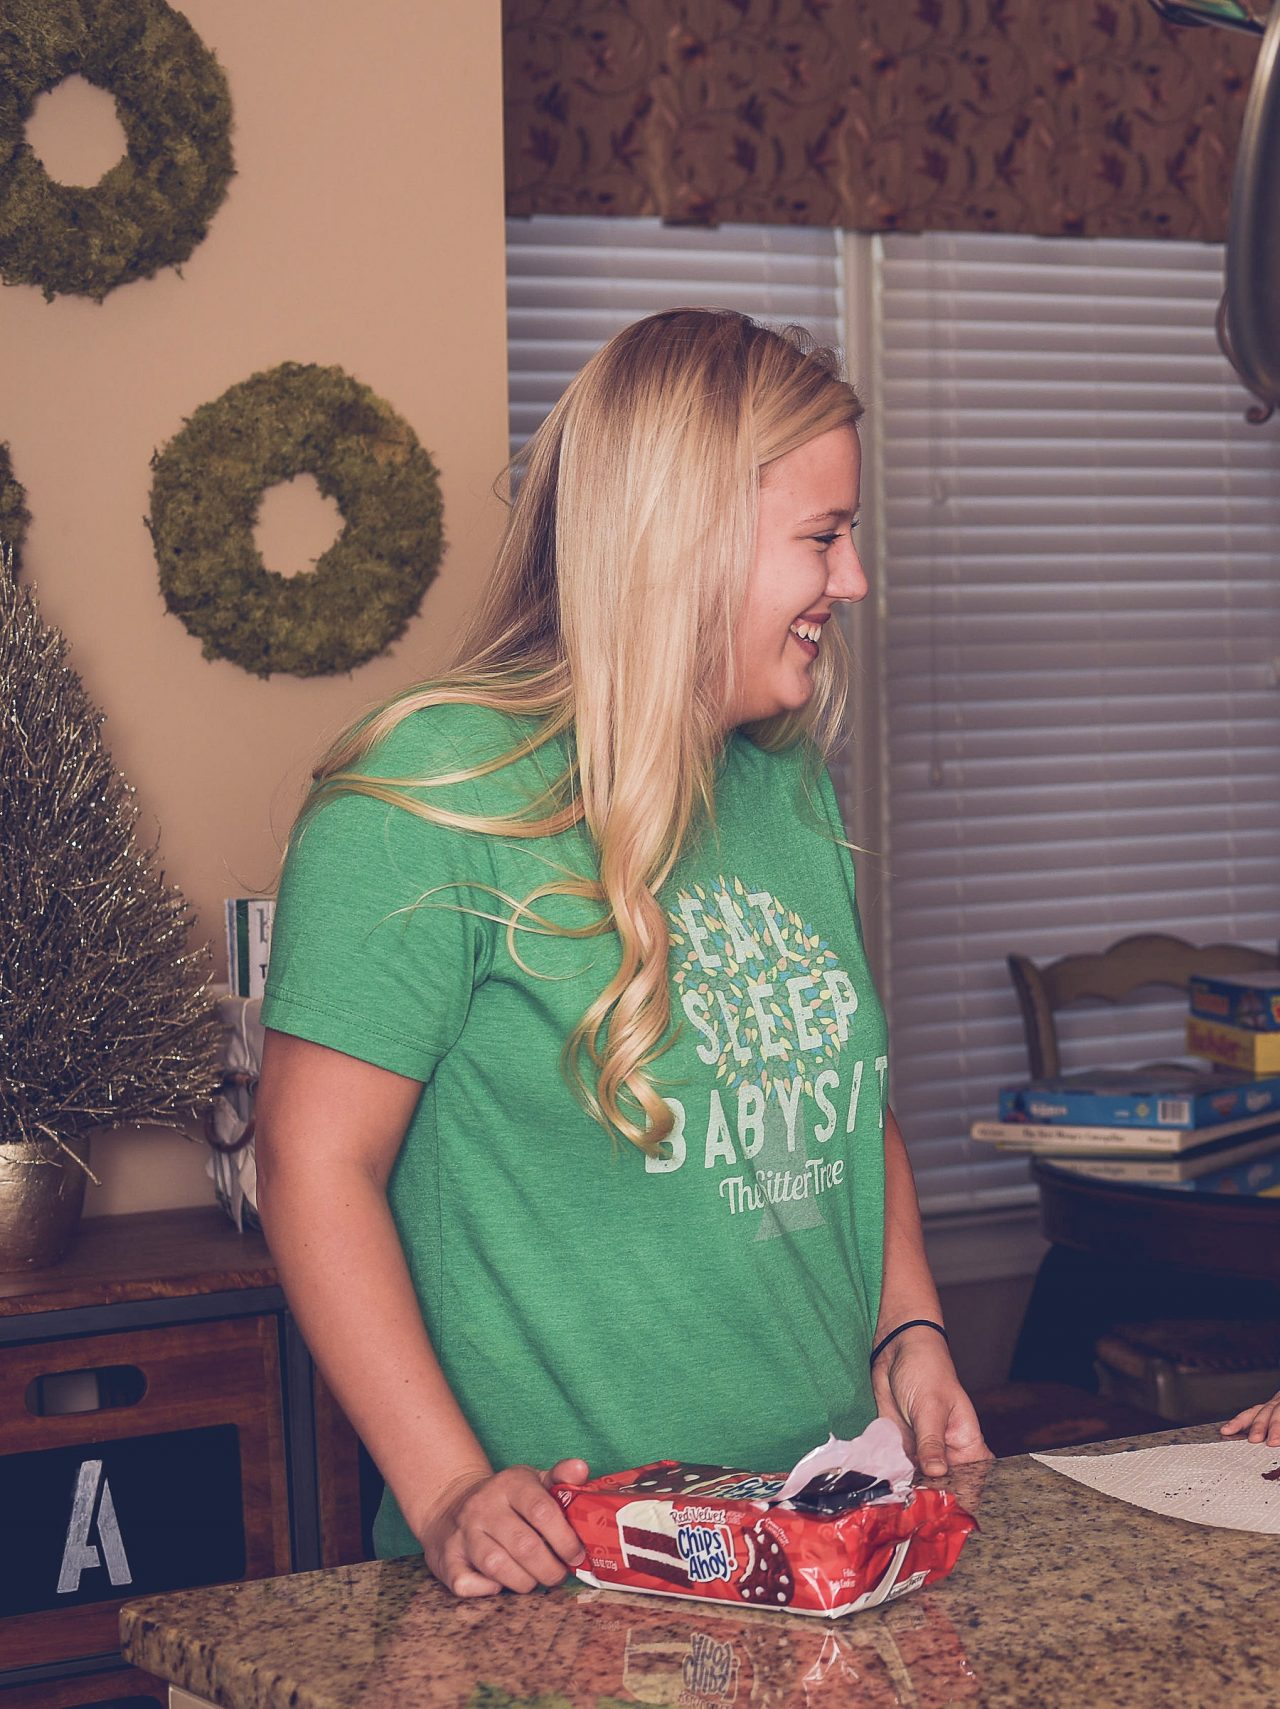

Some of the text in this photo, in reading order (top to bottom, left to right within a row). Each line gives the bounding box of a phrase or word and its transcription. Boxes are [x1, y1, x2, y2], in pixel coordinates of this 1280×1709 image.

[679, 891, 790, 969] EAT
[681, 970, 859, 1065] SLEEP
[57, 1459, 132, 1593] A
[669, 1506, 690, 1524] Red
[690, 1506, 726, 1524] Velvet
[677, 1526, 722, 1559] Chips
